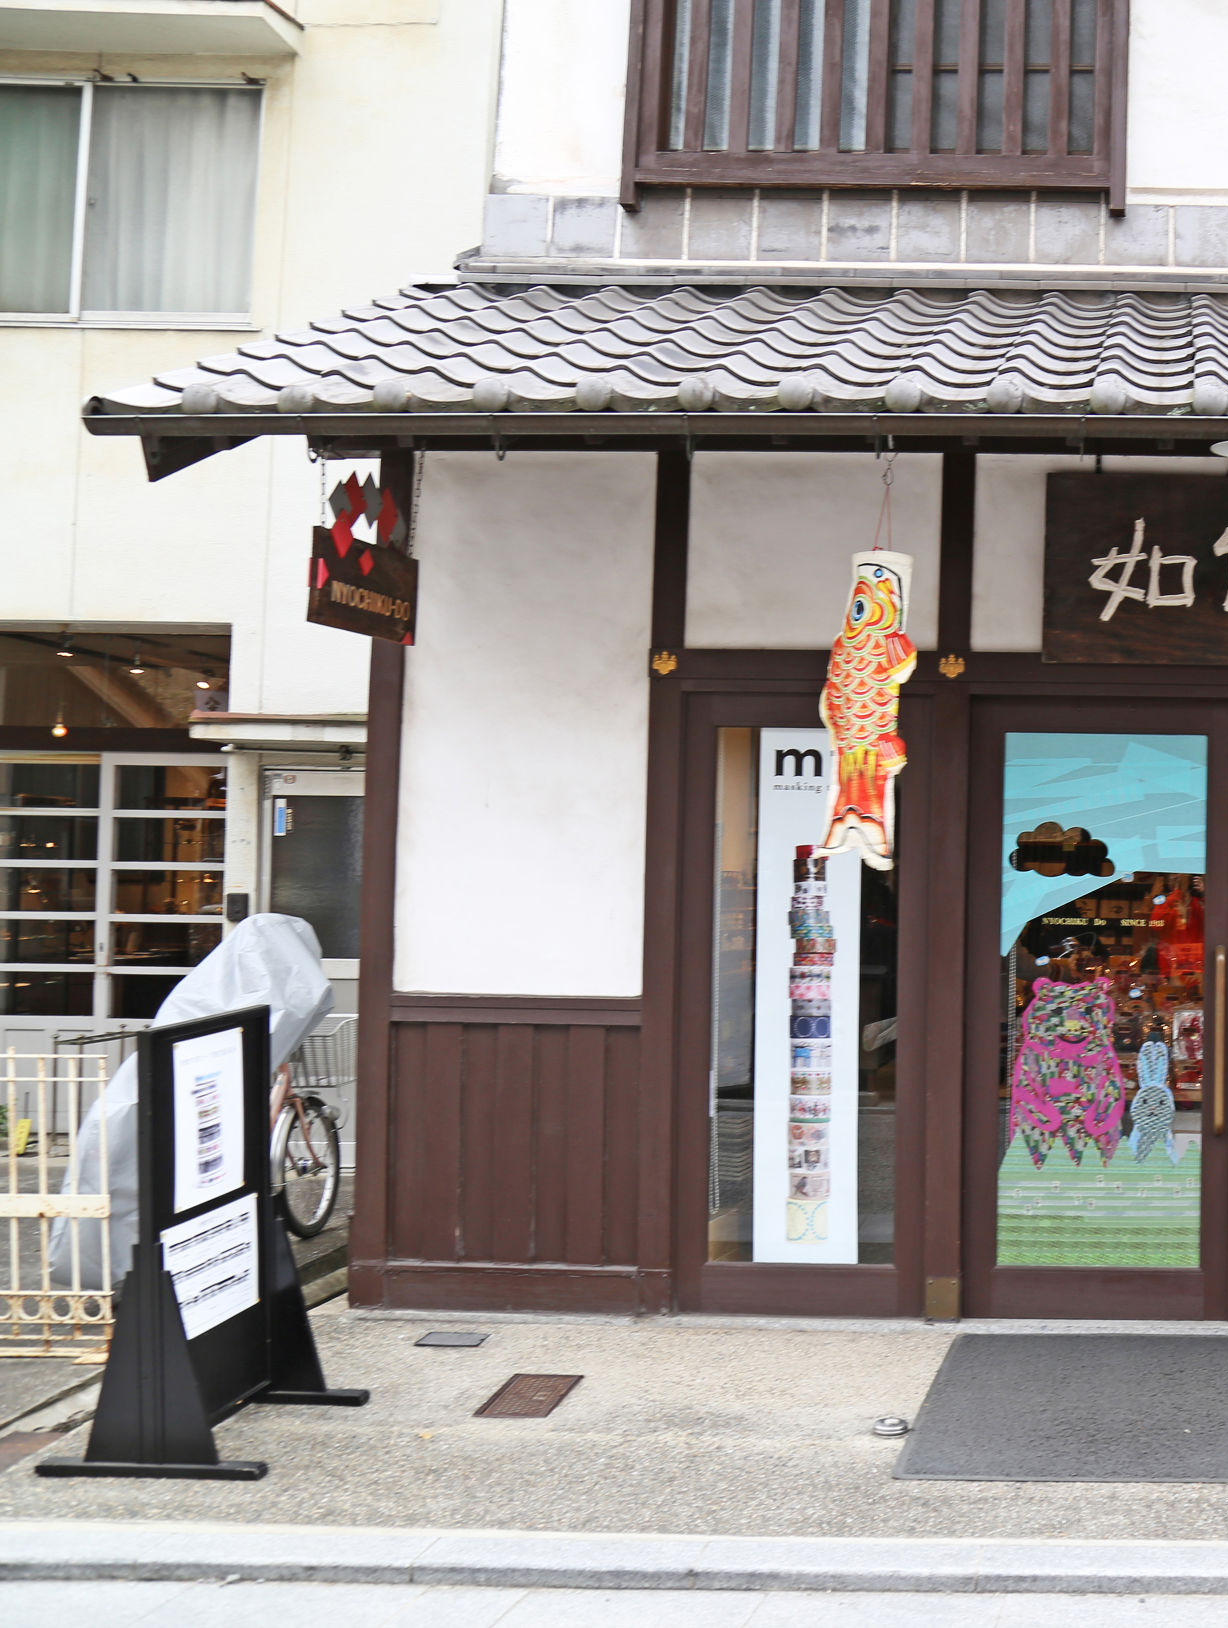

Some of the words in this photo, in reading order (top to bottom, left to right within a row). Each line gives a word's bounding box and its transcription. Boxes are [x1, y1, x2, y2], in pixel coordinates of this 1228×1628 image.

[330, 580, 411, 621] NYOCHIKU-DO
[774, 748, 837, 777] m
[773, 781, 823, 794] masking
[1120, 919, 1147, 927] SINCE
